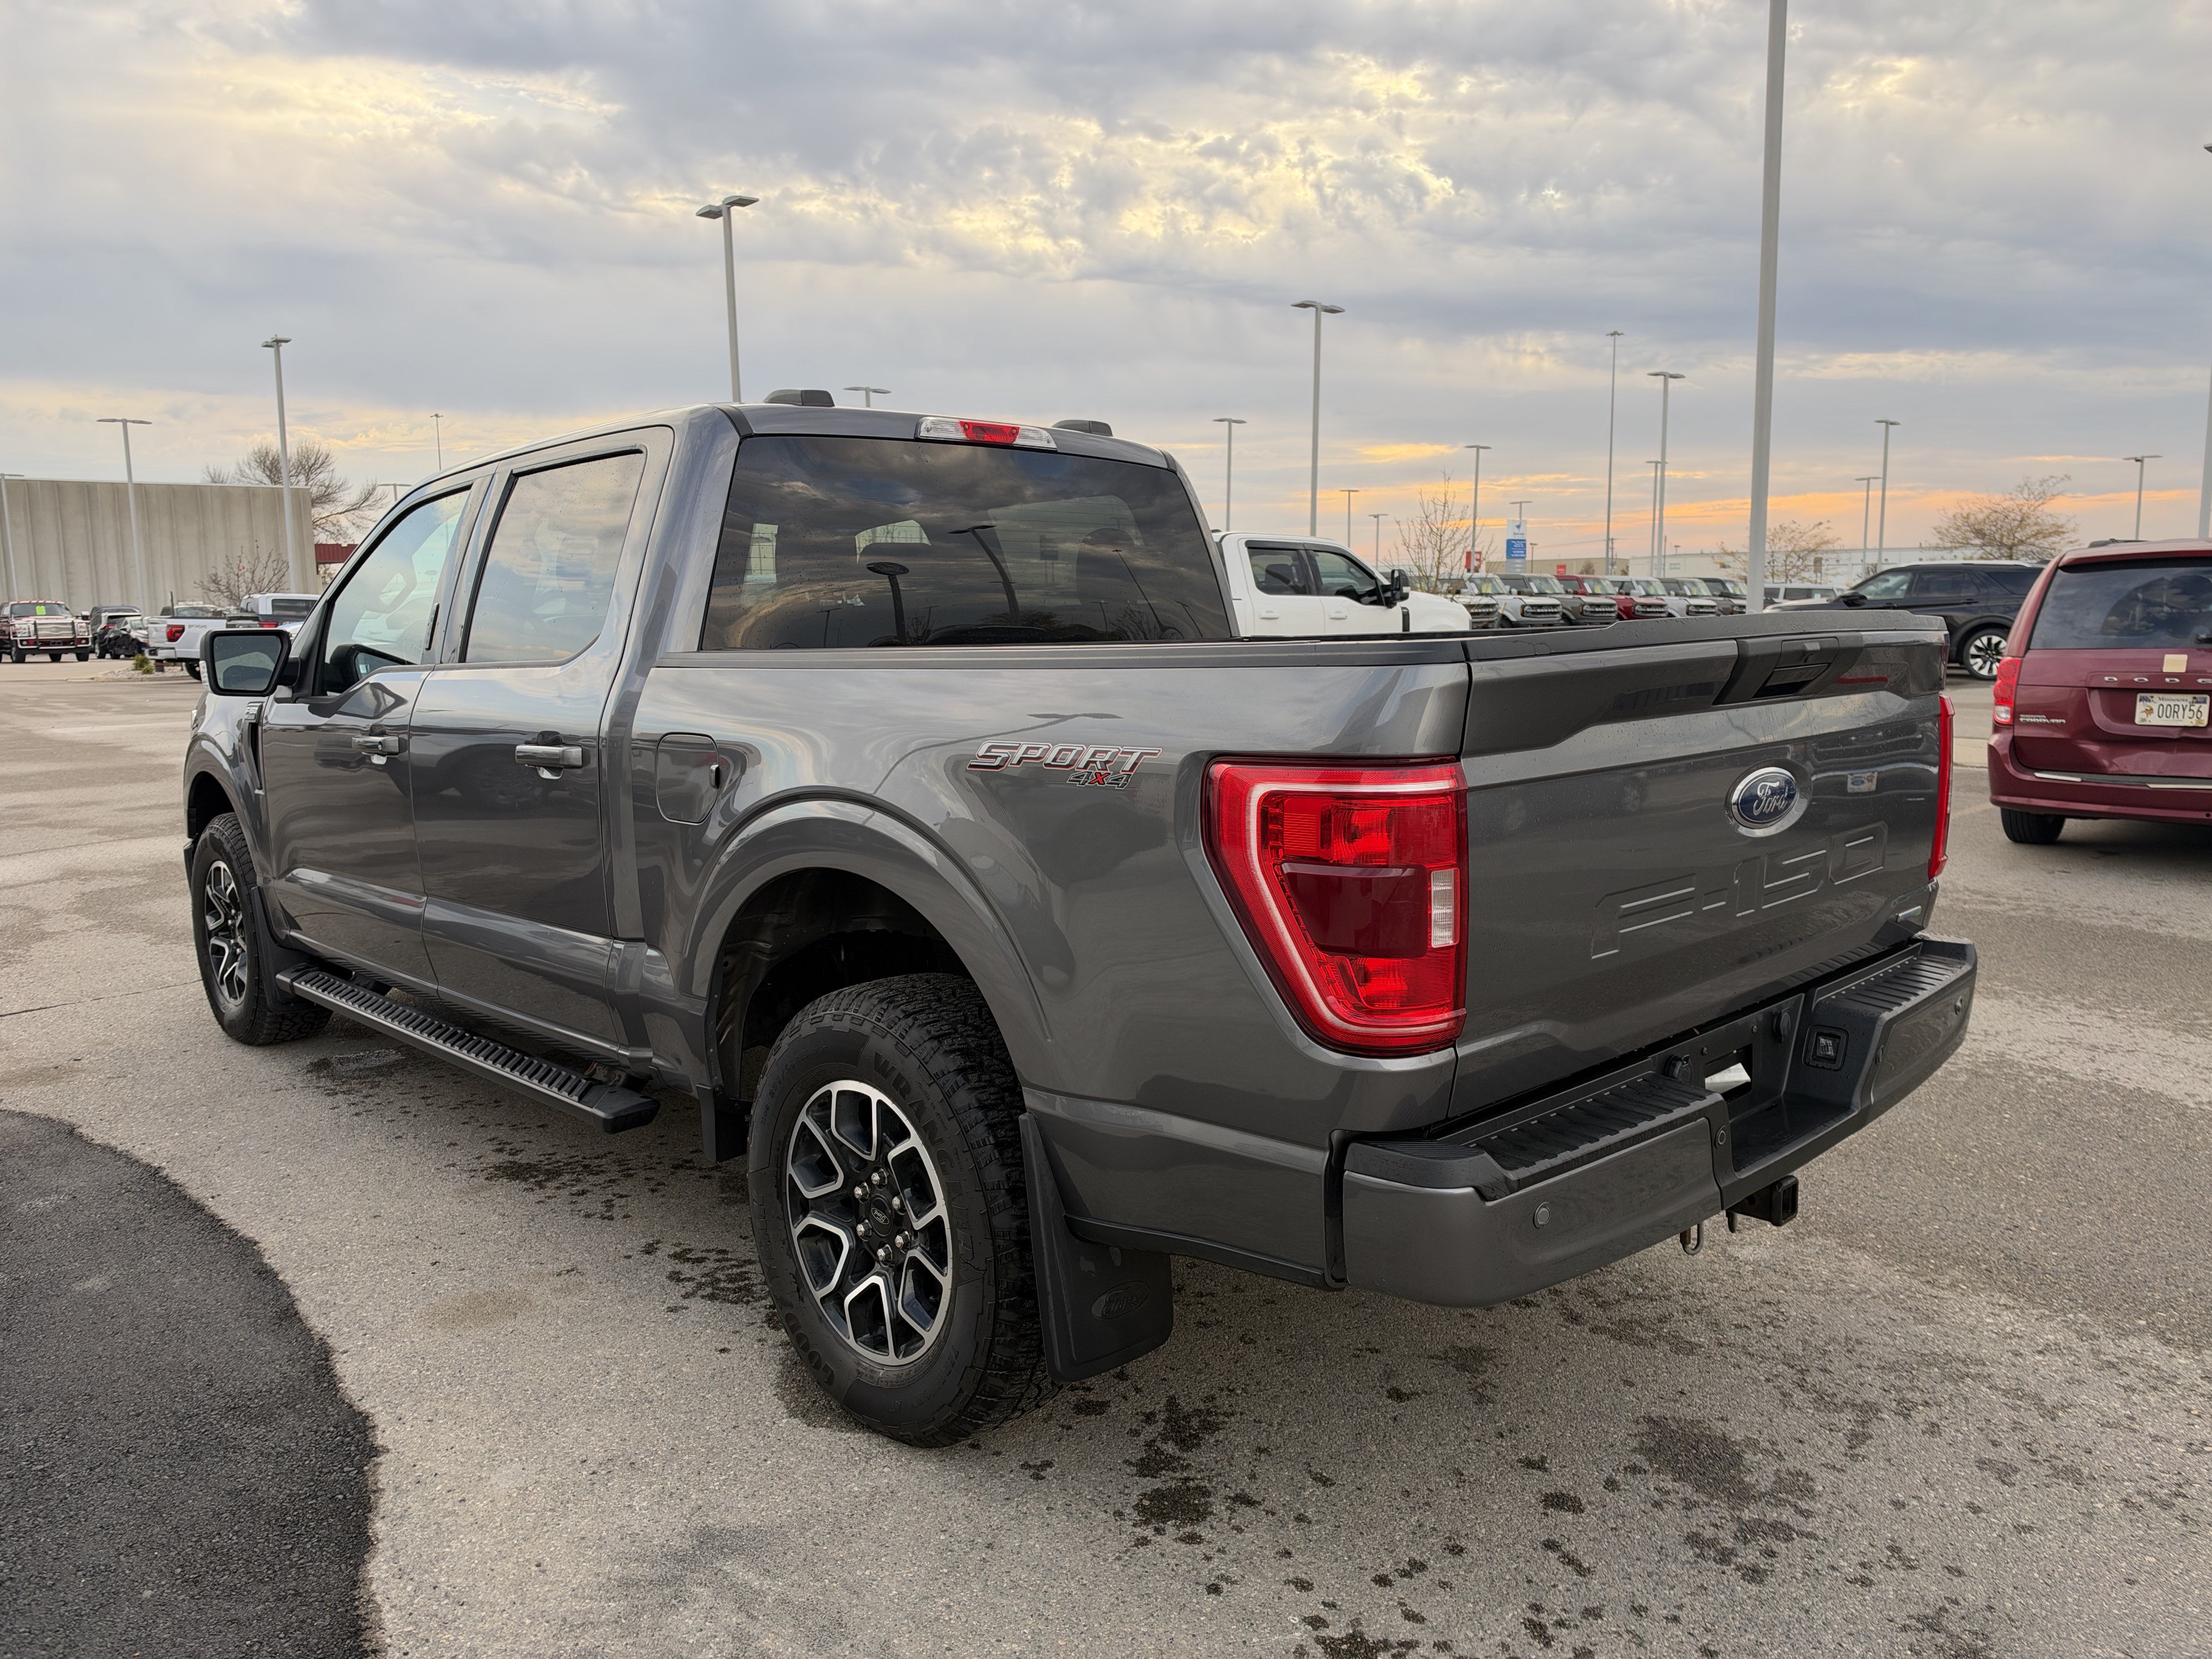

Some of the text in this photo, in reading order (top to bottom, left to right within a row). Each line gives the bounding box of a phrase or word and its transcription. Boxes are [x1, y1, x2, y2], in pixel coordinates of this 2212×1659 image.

[967, 740, 1162, 774] SPORT
[1752, 781, 1789, 816] Ford
[1591, 821, 1888, 959] F-150
[874, 1049, 973, 1261] WRANGLER
[874, 1209, 886, 1223] Ford
[1102, 1286, 1142, 1317] Ford
